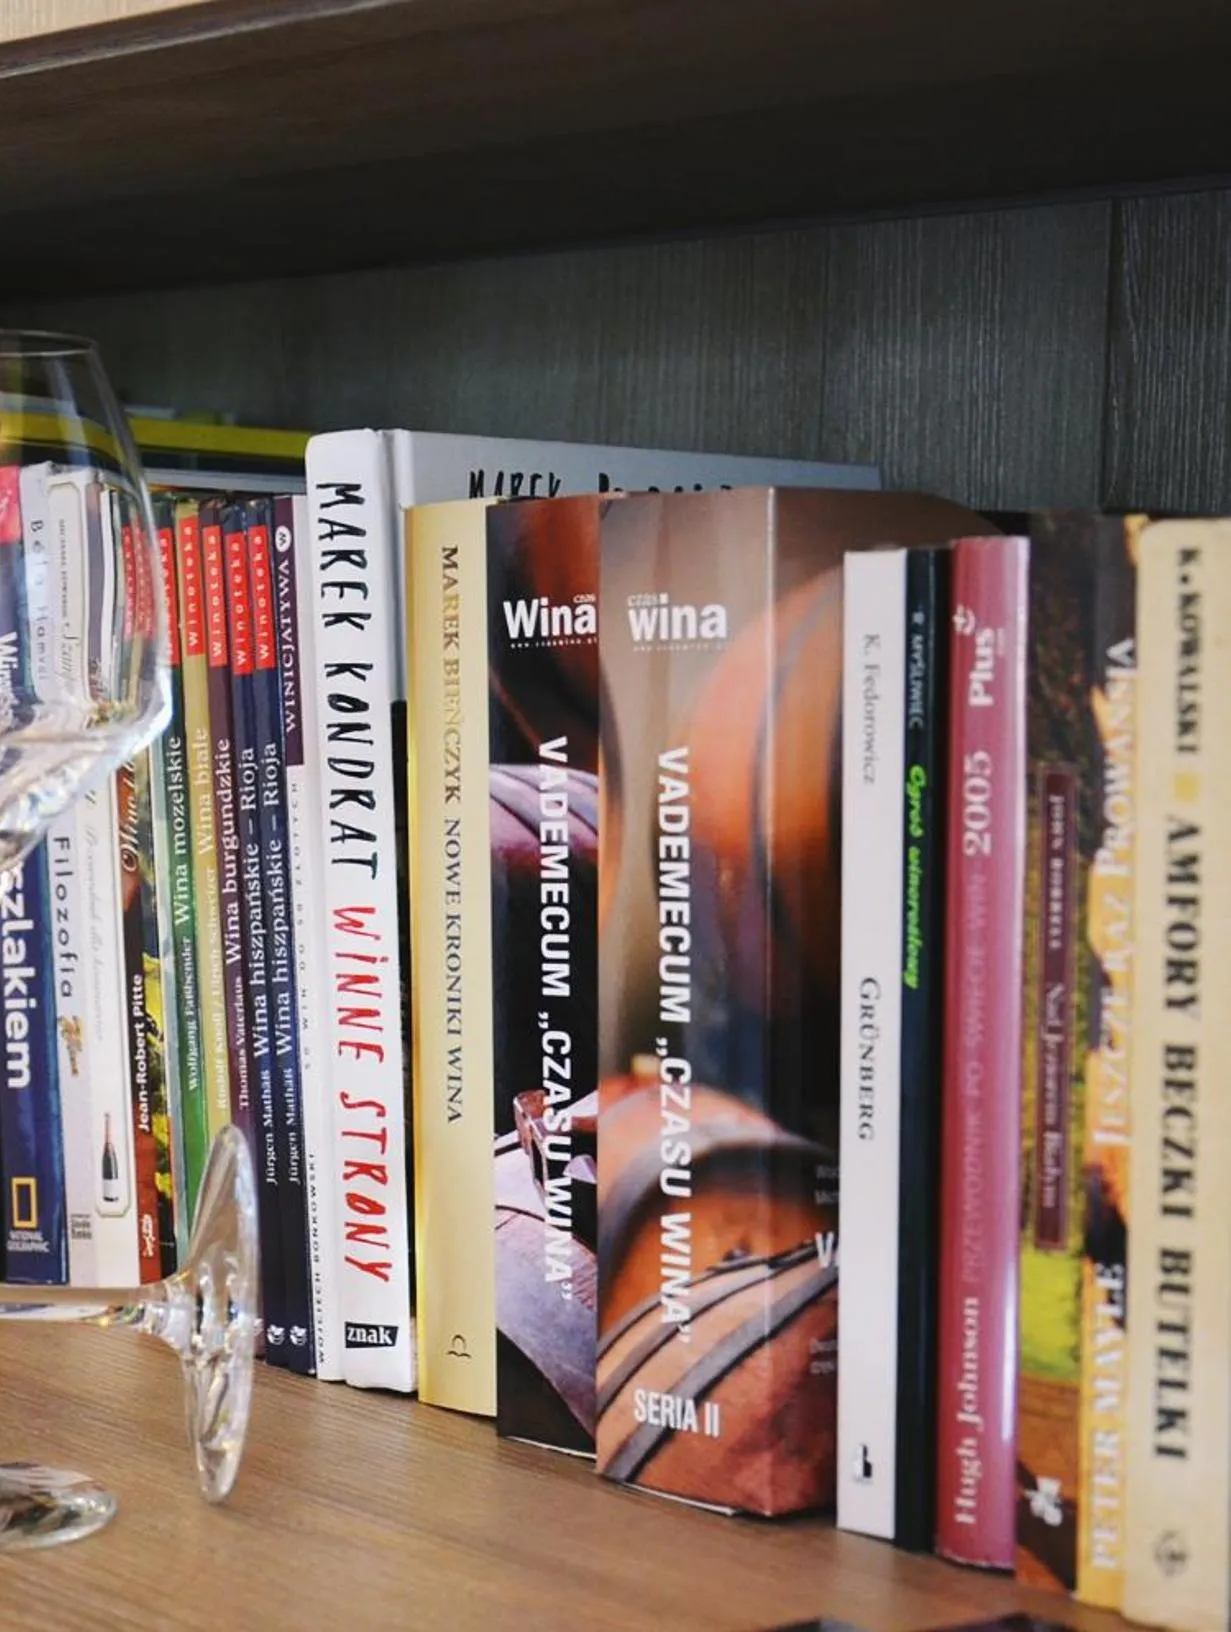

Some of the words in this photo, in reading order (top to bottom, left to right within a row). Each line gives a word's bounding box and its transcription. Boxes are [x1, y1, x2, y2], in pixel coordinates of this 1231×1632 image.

[316, 482, 372, 631] MAREK
[441, 546, 460, 650] MAREK
[276, 558, 297, 733] WINICJATYWA
[969, 628, 995, 708] Plus
[239, 747, 258, 810] Rioja
[262, 742, 280, 806] Rioja
[324, 662, 379, 881] KONDRAT
[863, 662, 881, 785] Fedorowicz
[163, 736, 186, 855] mozelskie
[196, 794, 214, 856] Wina
[214, 738, 240, 894] burgundzkie
[962, 751, 993, 857] 2005
[54, 836, 78, 998] Filozofia
[173, 864, 189, 927] Wina
[244, 843, 266, 986] hiszpańskie
[266, 840, 289, 983] hiszpańskie
[444, 817, 462, 906] NOWE
[539, 736, 570, 997] VADEMECUM
[658, 747, 692, 1023] VADEMECUM
[1165, 815, 1202, 1014] AMFORY
[225, 902, 242, 965] Wina
[446, 914, 463, 1035] KRONIKI
[130, 973, 146, 1018] Pitte
[253, 994, 269, 1059] Wina
[275, 992, 293, 1057] Wina
[134, 1023, 151, 1133] Jean-Robert
[237, 1049, 249, 1110] Thomas
[448, 1045, 464, 1125] WINA
[1161, 1043, 1199, 1218] BECZKI
[339, 1090, 393, 1283] STRONY
[347, 1325, 393, 1346] znak
[955, 1297, 985, 1432] Johnson
[1092, 1262, 1126, 1412] MAYLE
[1154, 1248, 1194, 1460] BUTELKI
[634, 1390, 699, 1434] SERIA
[704, 1404, 721, 1438] II
[954, 1438, 983, 1525] Hugh
[1092, 1431, 1120, 1568] PETER
